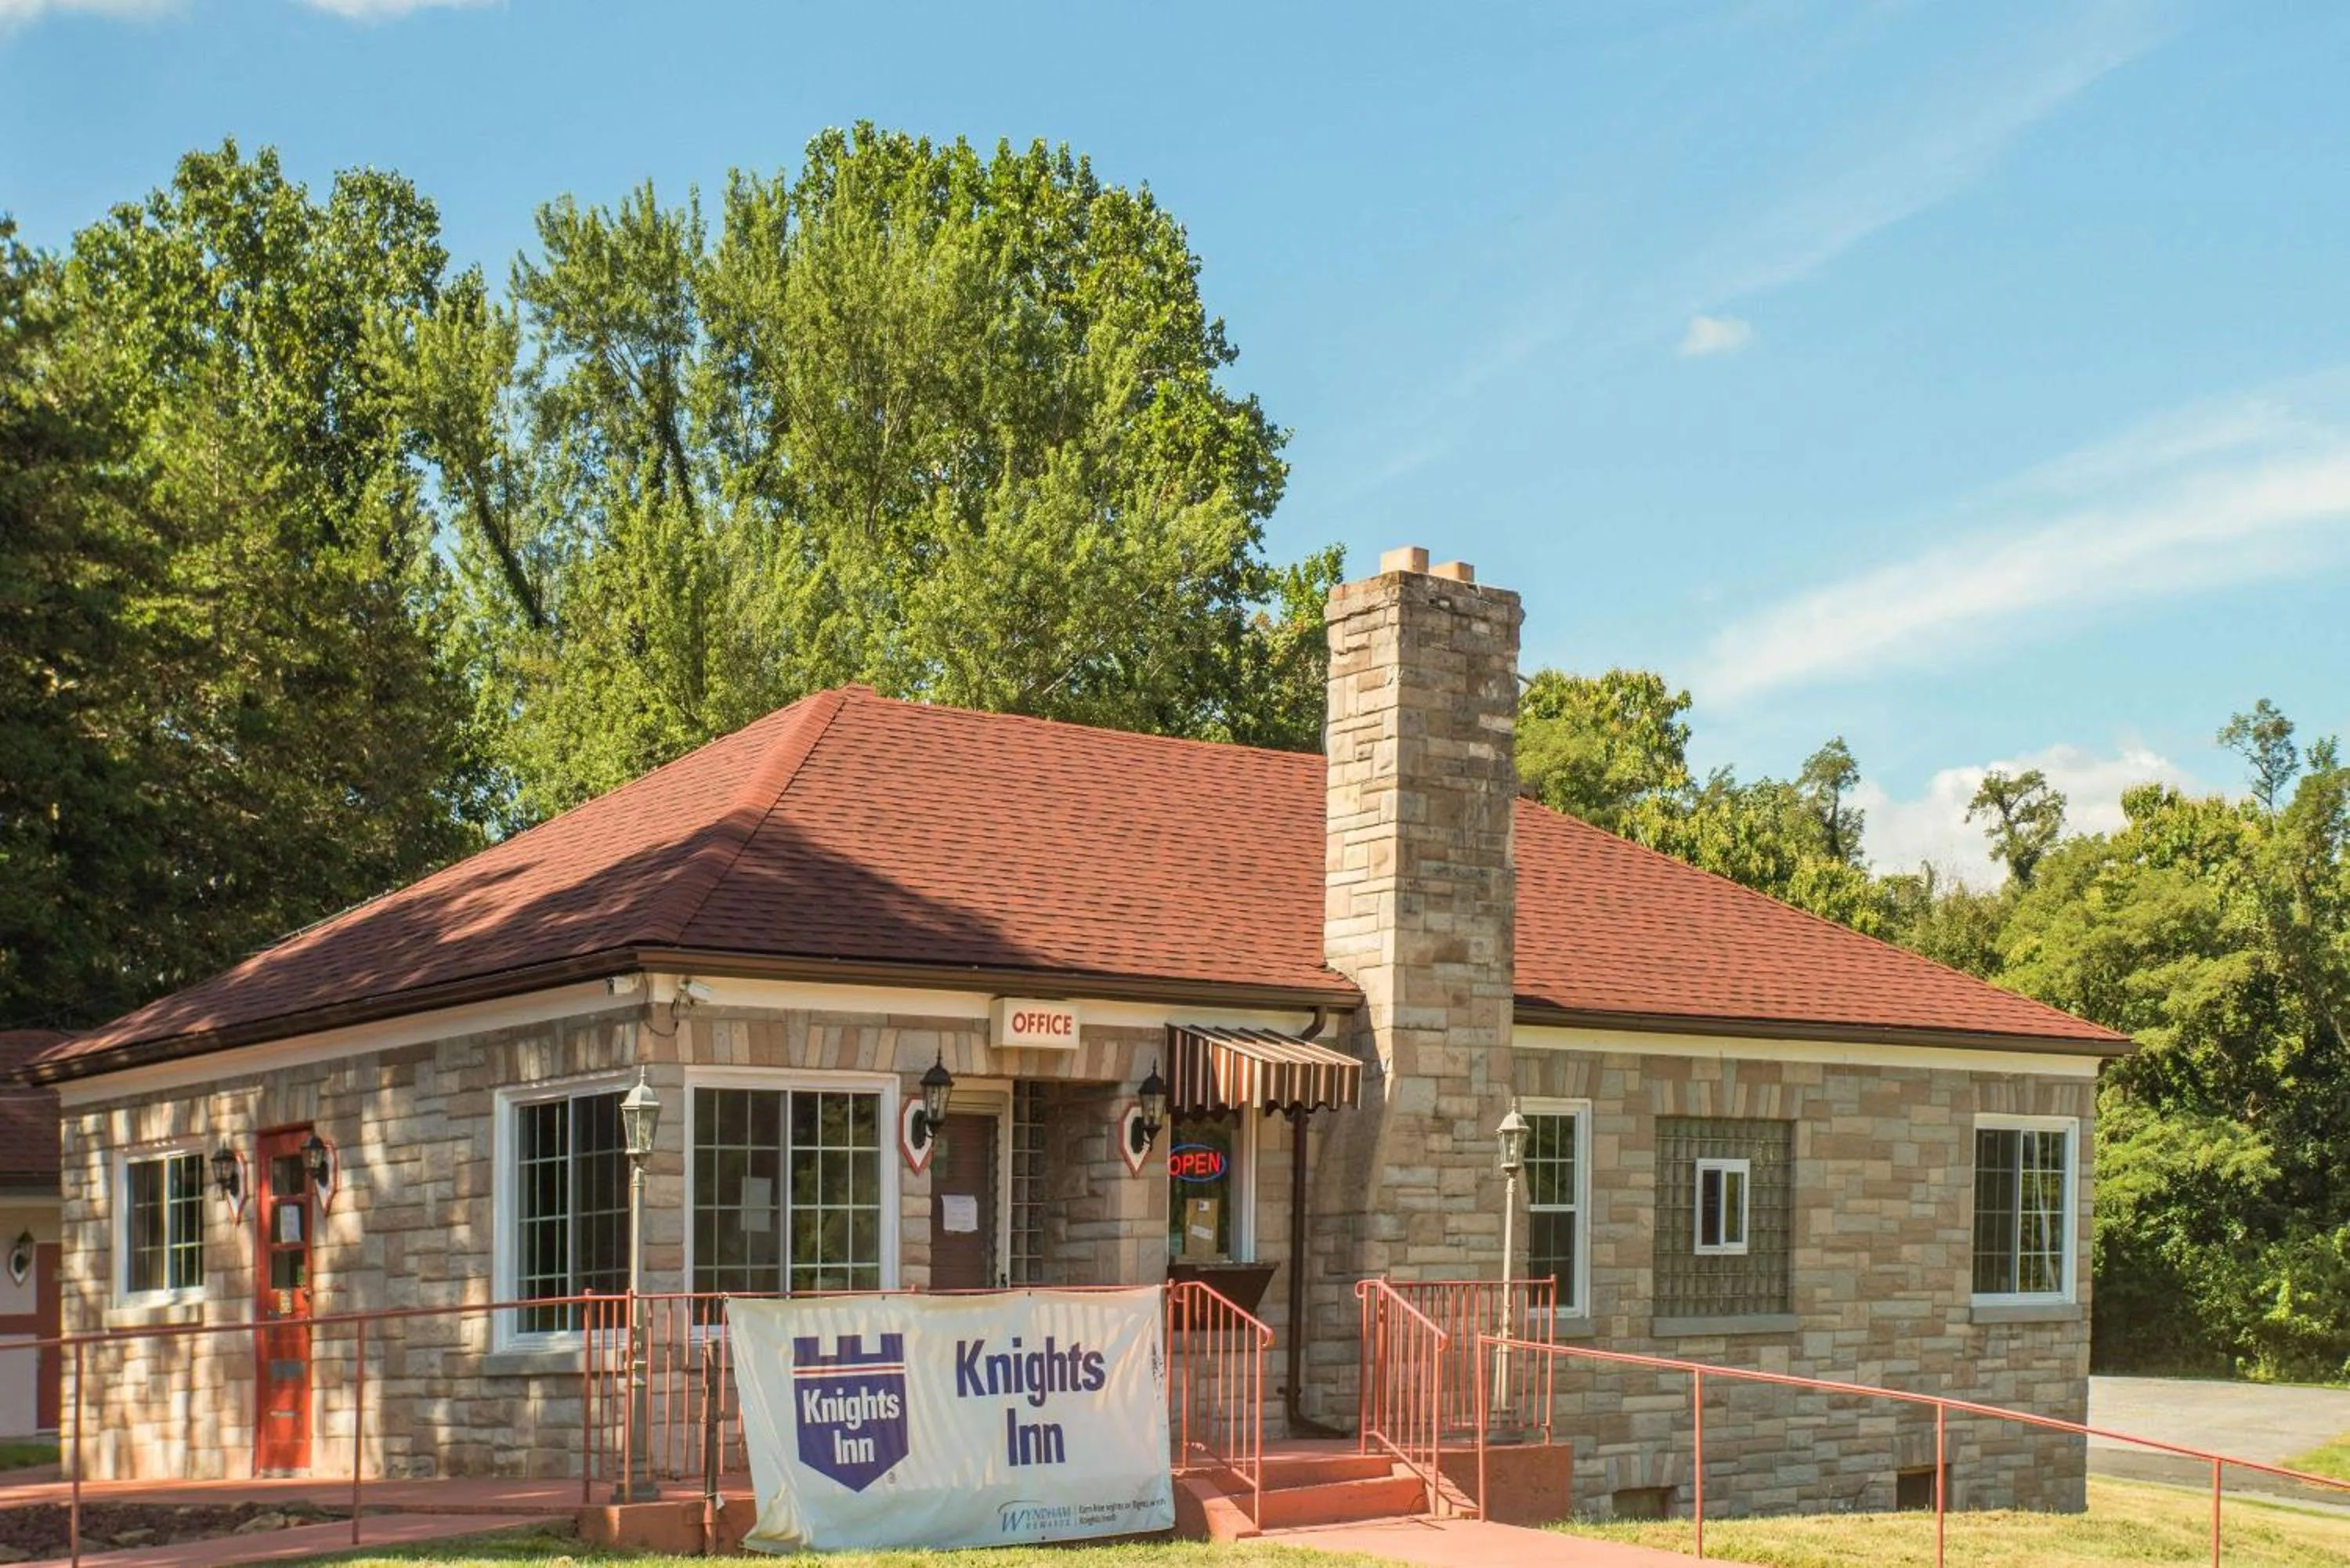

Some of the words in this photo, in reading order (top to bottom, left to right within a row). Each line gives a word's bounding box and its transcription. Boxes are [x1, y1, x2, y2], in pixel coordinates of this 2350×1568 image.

[1012, 1011, 1072, 1035] OFFICE
[1167, 1152, 1221, 1176] OPEN
[956, 1336, 1106, 1407] Knights
[803, 1386, 900, 1429] Knights
[833, 1429, 876, 1465] Inn
[1007, 1408, 1066, 1467] Inn
[1002, 1506, 1072, 1532] WYNDHAM
